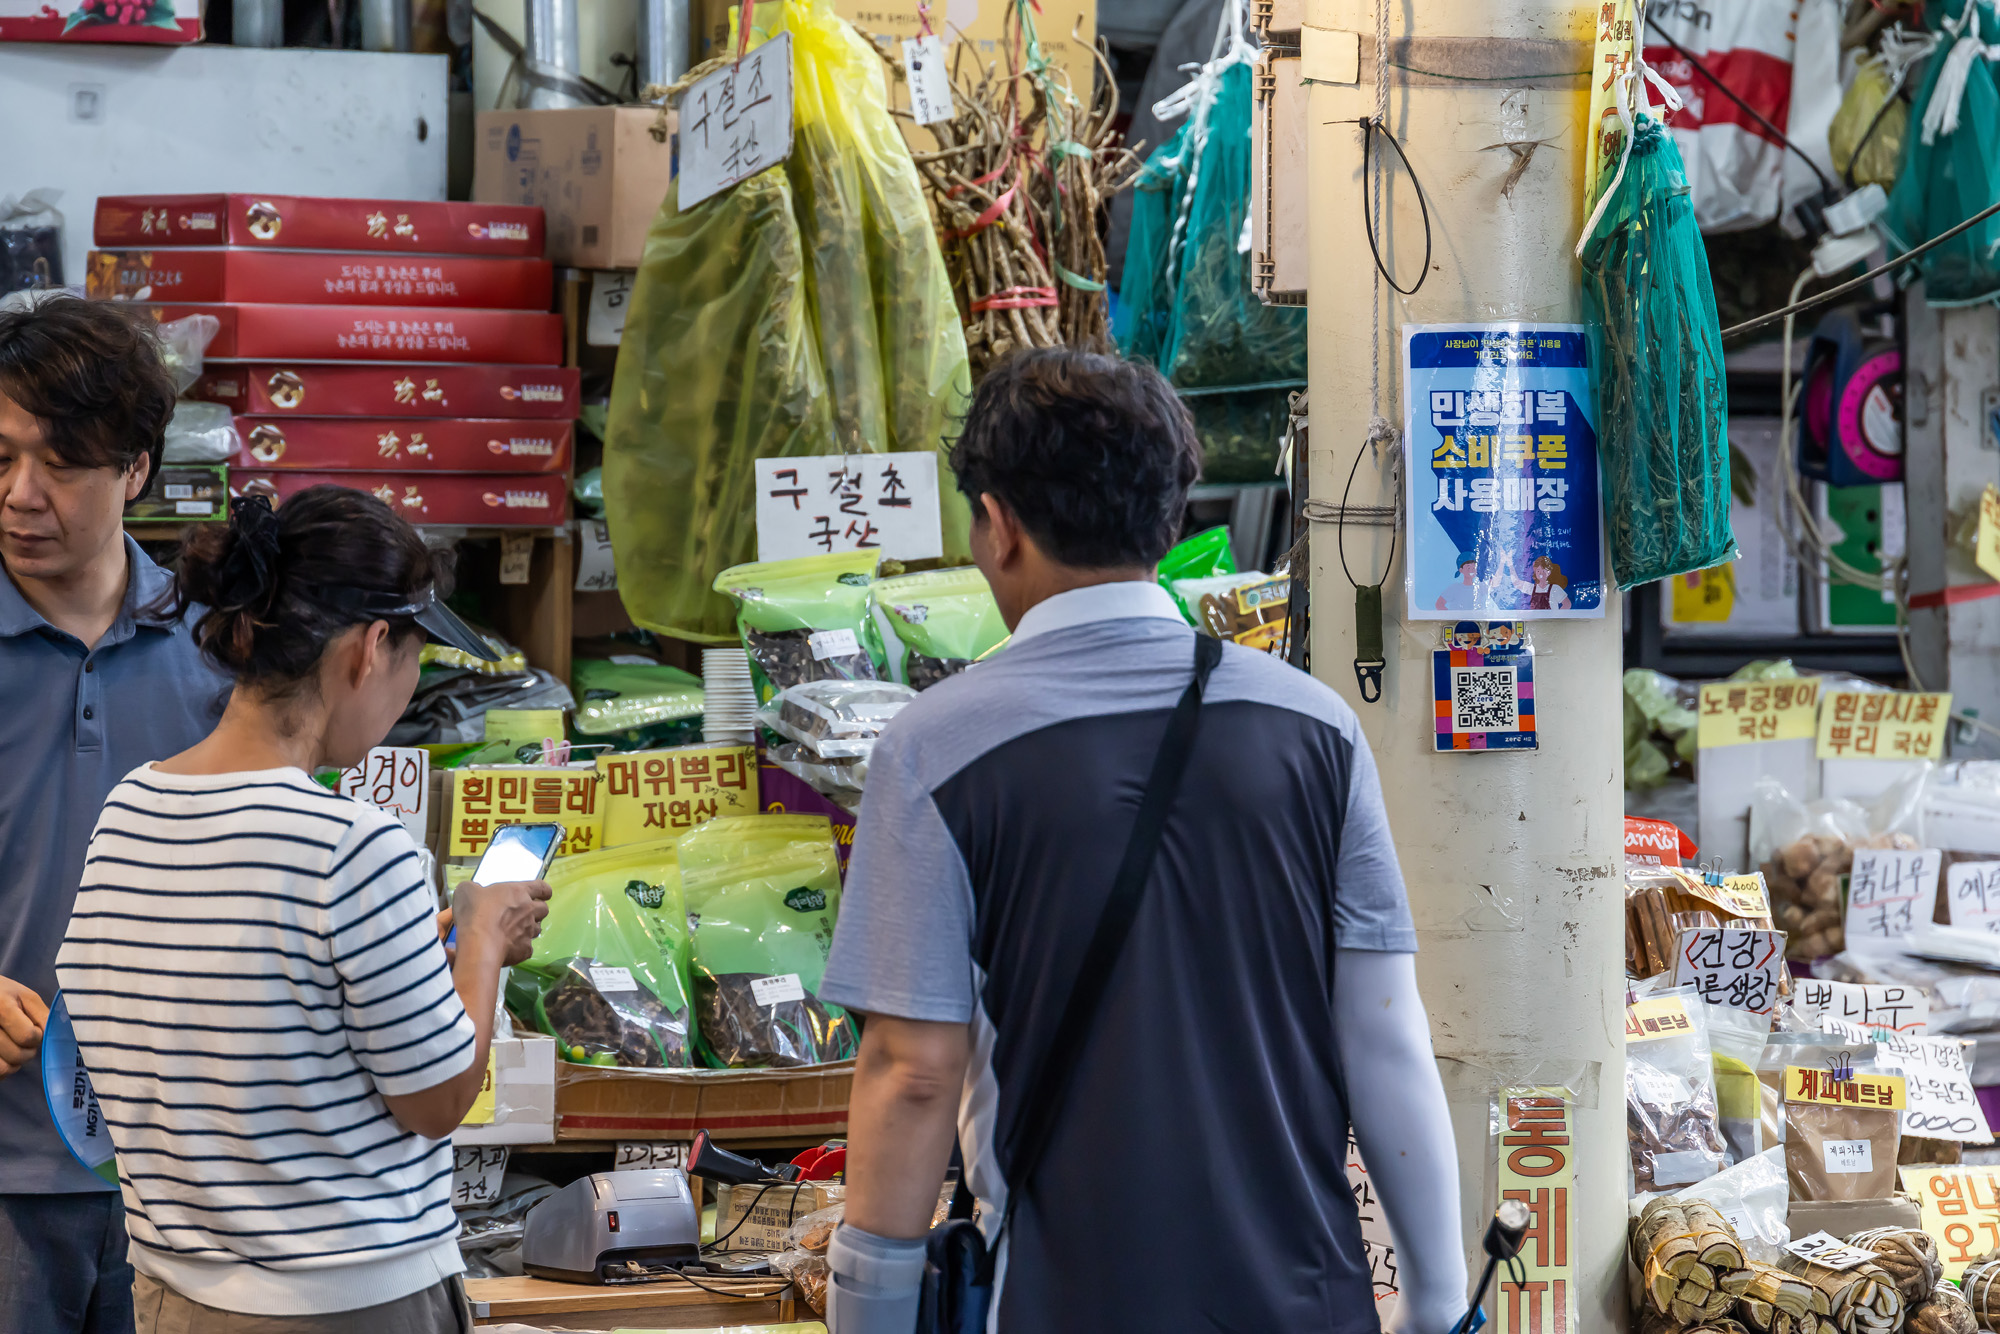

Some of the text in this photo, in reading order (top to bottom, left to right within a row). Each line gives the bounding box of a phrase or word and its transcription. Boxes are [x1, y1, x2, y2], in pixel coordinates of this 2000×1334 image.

[691, 55, 772, 149] 구절초
[722, 120, 761, 180] 국산
[324, 279, 356, 294] 농촌의
[341, 266, 372, 279] 도시는
[388, 266, 418, 280] 농촌은
[422, 267, 443, 280] 뿌리
[337, 334, 368, 348] 농촌의
[353, 320, 384, 333] 도시는
[399, 321, 431, 335] 농촌은
[434, 322, 454, 335] 뿌리
[1444, 339, 1479, 349] 사장님이
[1539, 339, 1561, 349] 사용을
[1431, 390, 1567, 427] 민생회복
[1433, 435, 1568, 469] 소비쿠폰
[769, 462, 912, 516] 구절초
[1433, 477, 1569, 512] 사용매장
[808, 516, 880, 552] 국산
[1834, 691, 1941, 725] 흰접시꽃
[1739, 714, 1778, 740] 국산
[1829, 725, 1933, 756] 뿌리 국산
[607, 753, 747, 798] 머위뿌리
[462, 776, 596, 815] 흰민들레
[643, 798, 719, 829] 자연산
[1642, 1013, 1690, 1033] 베트남
[72, 1070, 87, 1109] 뿌리가
[1798, 1069, 1894, 1105] 계피 베트남
[85, 1099, 100, 1137] MG가
[1906, 1111, 1977, 1134] 000
[618, 1142, 681, 1168] 오가피
[456, 1175, 488, 1203] 국산
